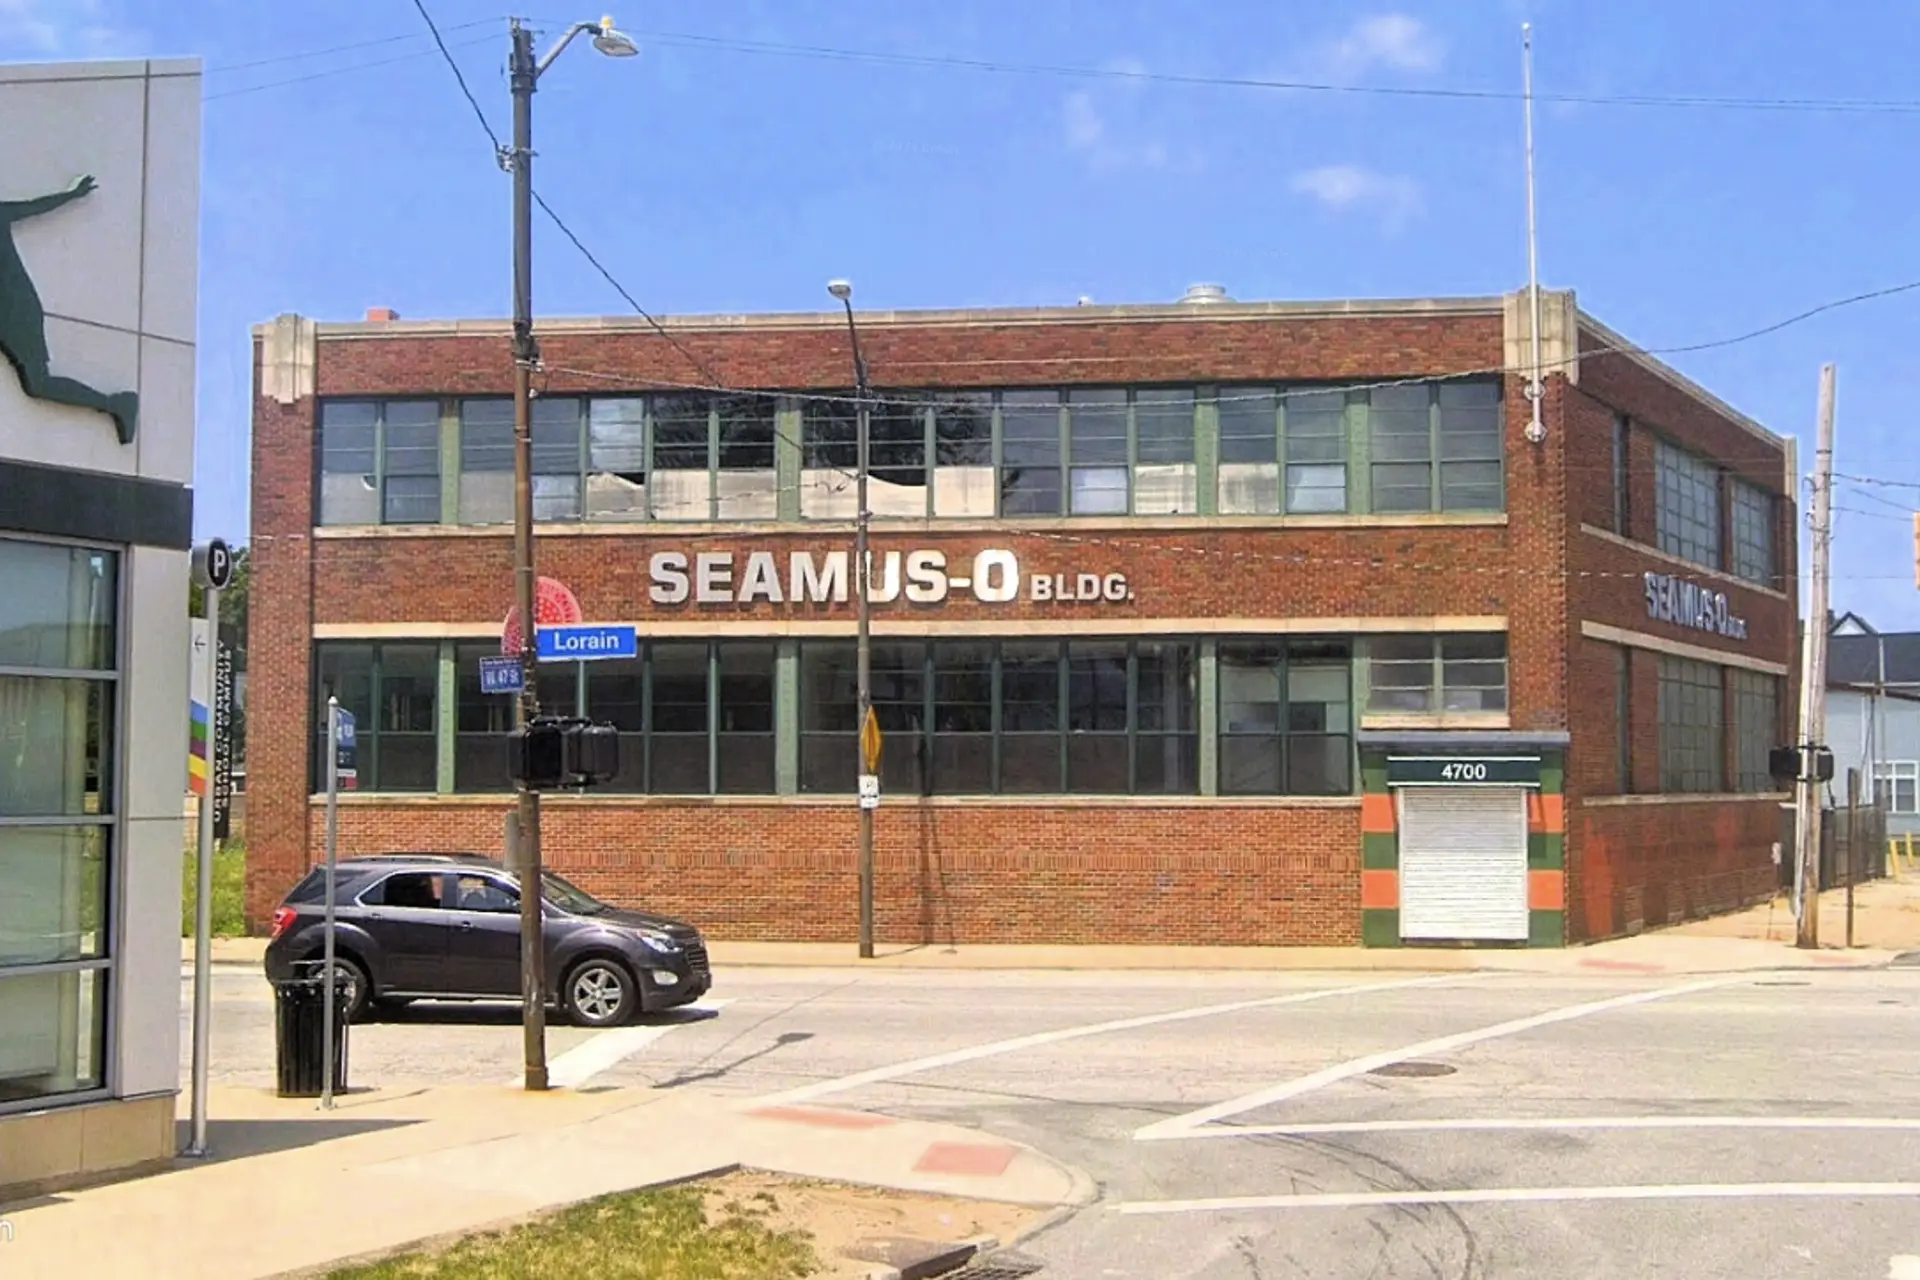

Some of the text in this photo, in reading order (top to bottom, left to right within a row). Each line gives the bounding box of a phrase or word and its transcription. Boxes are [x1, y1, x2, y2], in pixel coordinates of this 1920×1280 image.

[213, 549, 225, 576] P
[649, 548, 1135, 604] SEAMUS-O BLDG.
[554, 631, 619, 651] Lorain
[213, 640, 224, 823] URBAN COMMUNITY
[1441, 763, 1487, 780] 4700
